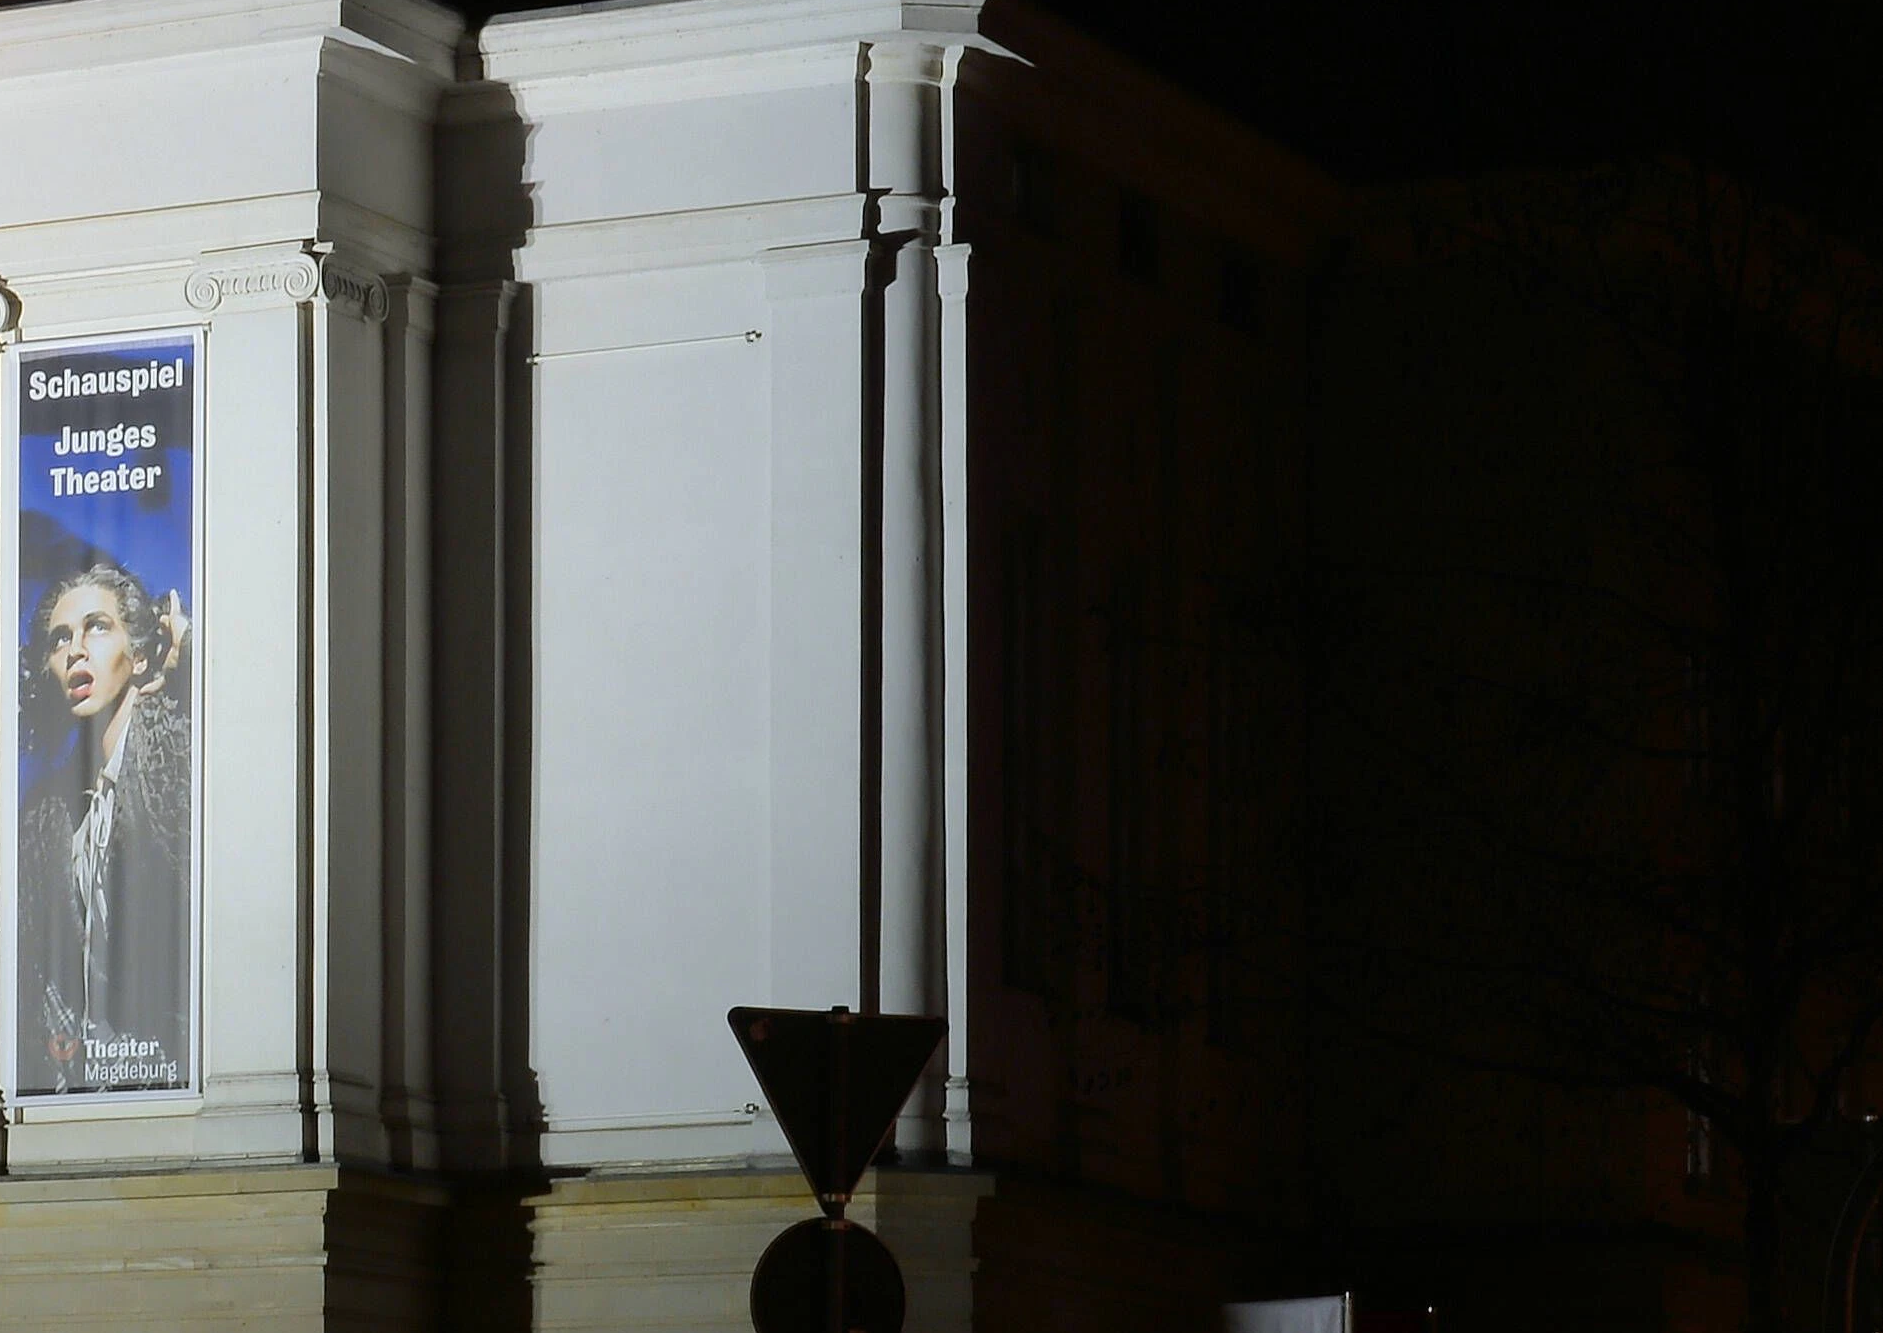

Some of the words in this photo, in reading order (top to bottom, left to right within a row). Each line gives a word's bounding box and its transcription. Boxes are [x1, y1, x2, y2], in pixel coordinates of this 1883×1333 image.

[28, 357, 184, 402] Schauspiel
[54, 422, 157, 457] Junges
[49, 463, 162, 497] Theater
[84, 1038, 160, 1059] Theater
[84, 1060, 178, 1083] Magdeburg
